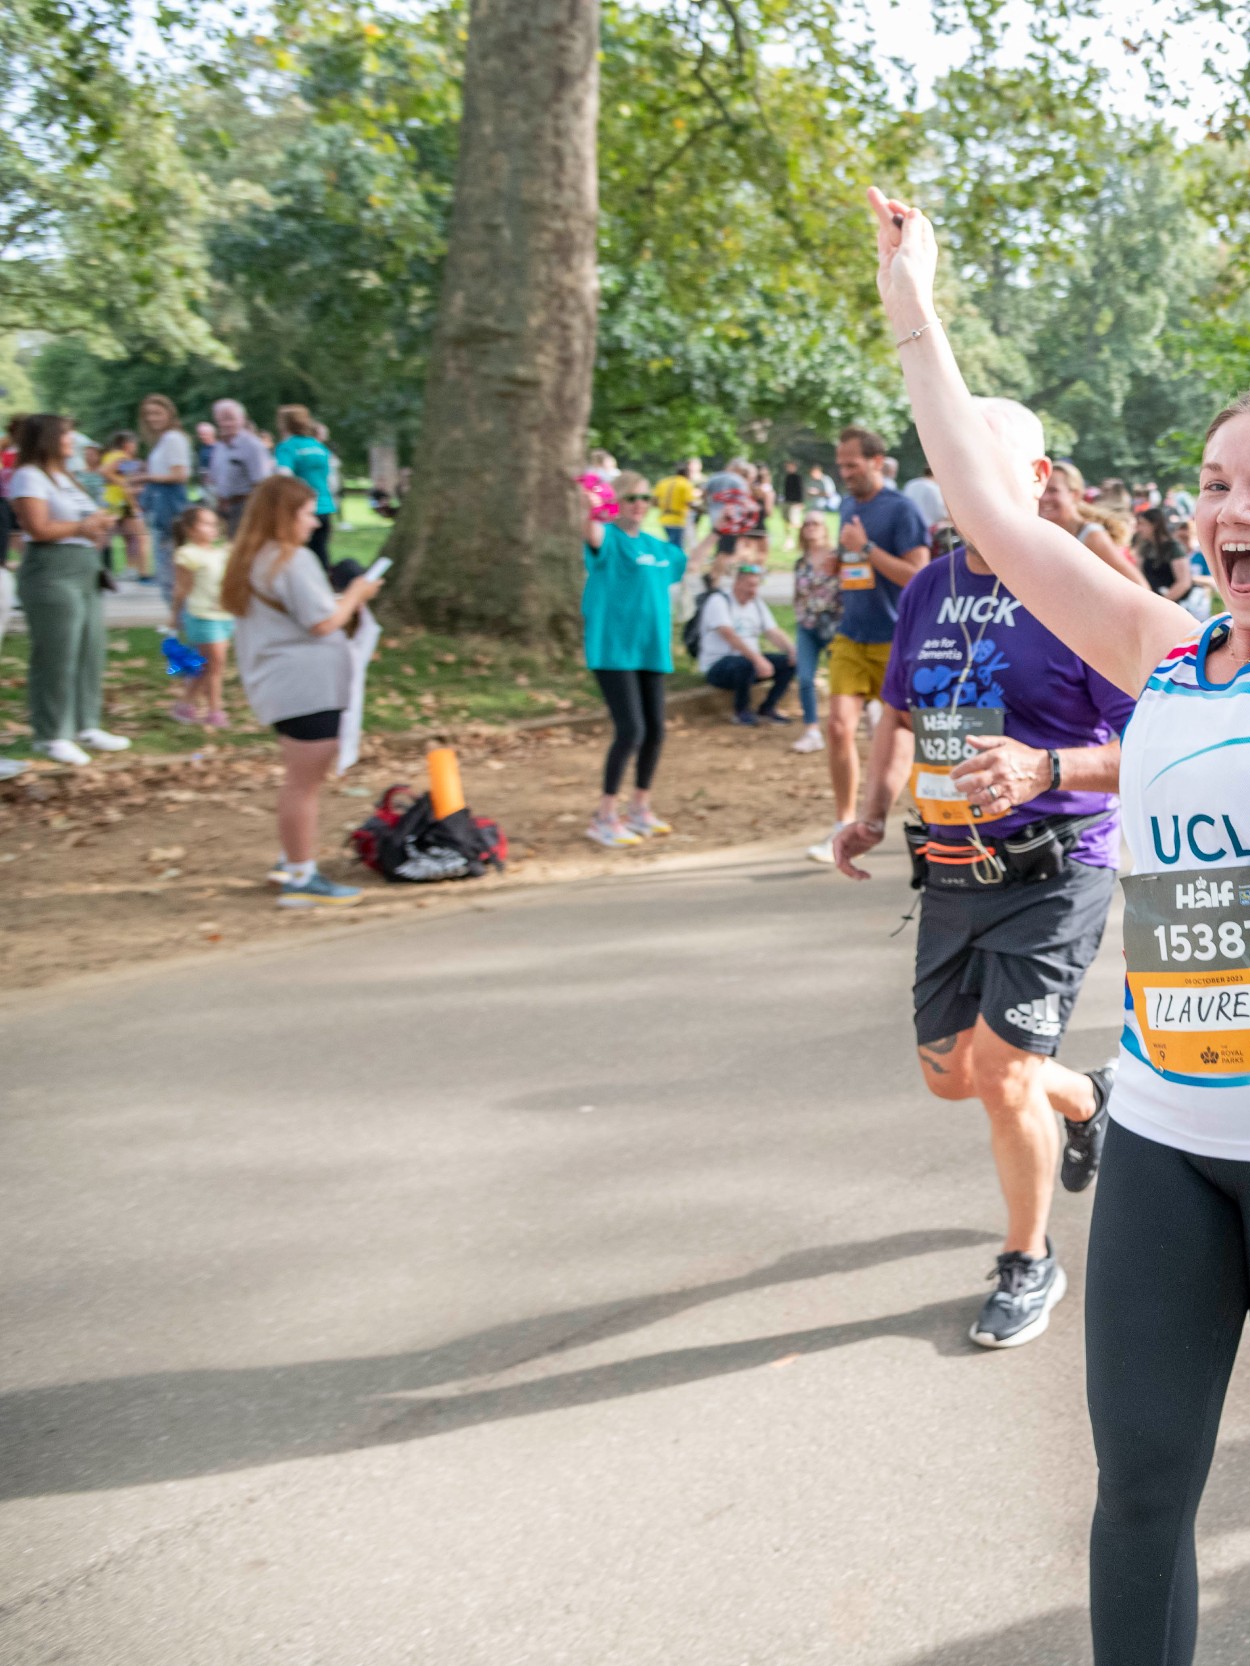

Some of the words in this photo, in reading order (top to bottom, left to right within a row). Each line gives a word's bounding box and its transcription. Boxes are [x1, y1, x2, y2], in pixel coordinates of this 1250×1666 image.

[936, 595, 1023, 627] NICK
[1176, 880, 1235, 909] Half
[1193, 976, 1225, 984] OCTOBER
[1160, 1050, 1166, 1060] 9
[1221, 1049, 1243, 1057] ROYAL
